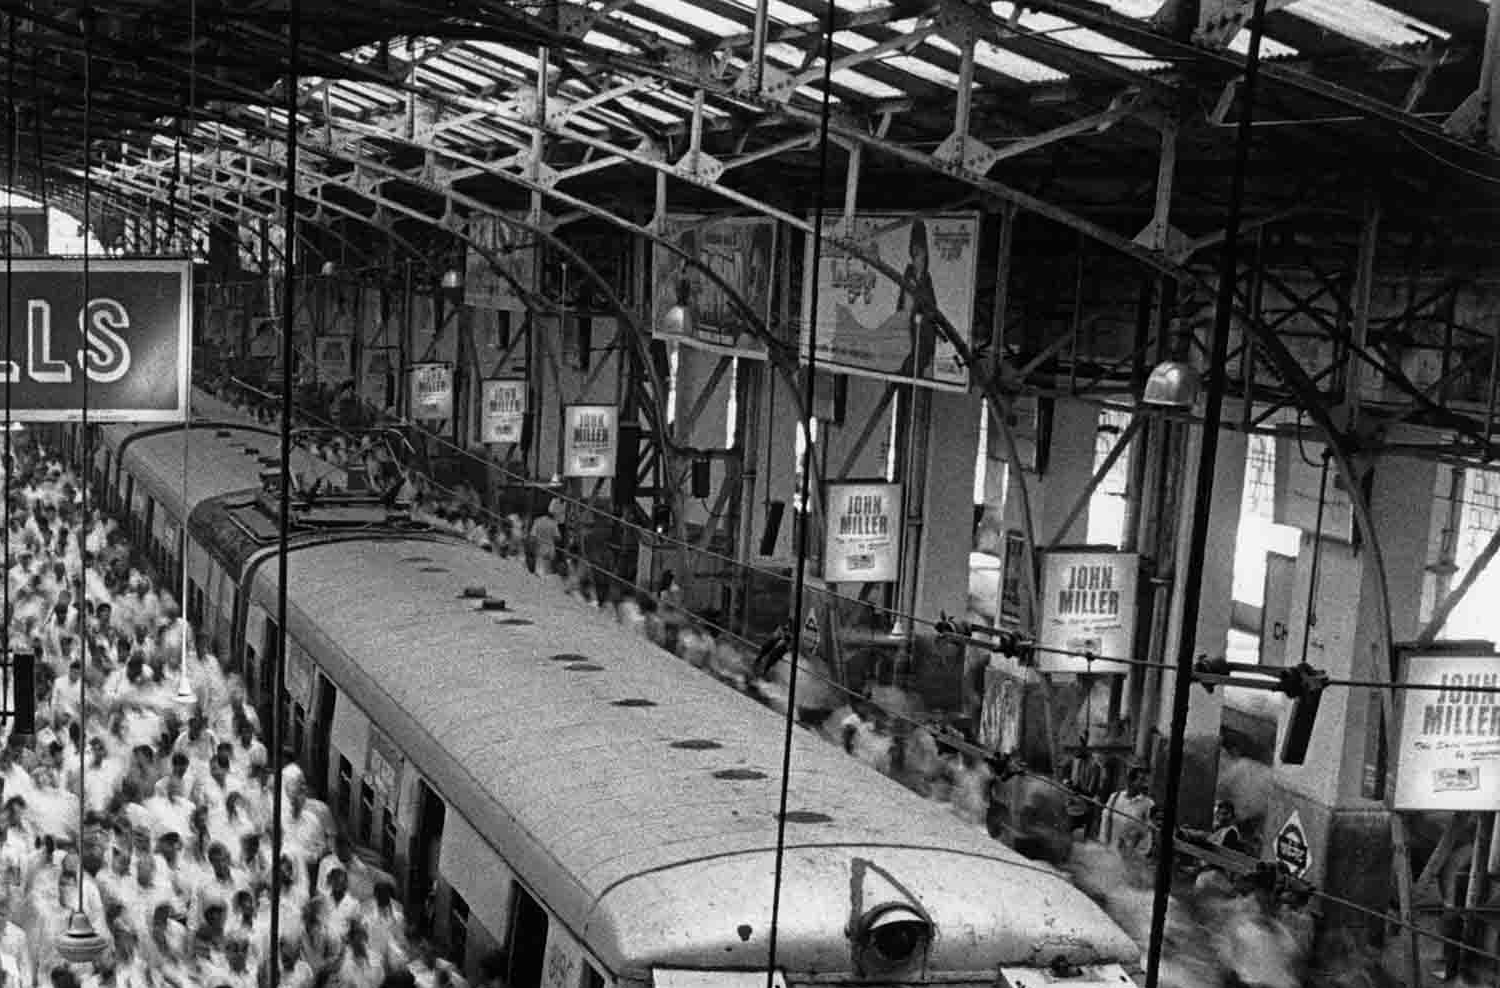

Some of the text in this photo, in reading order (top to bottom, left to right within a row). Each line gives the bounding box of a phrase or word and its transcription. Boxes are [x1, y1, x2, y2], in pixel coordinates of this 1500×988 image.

[846, 495, 882, 514] JOHN
[840, 515, 888, 535] MILLER
[1067, 566, 1113, 590] JOHN
[1058, 592, 1119, 614] MILLER
[1438, 672, 1498, 704] JOHN
